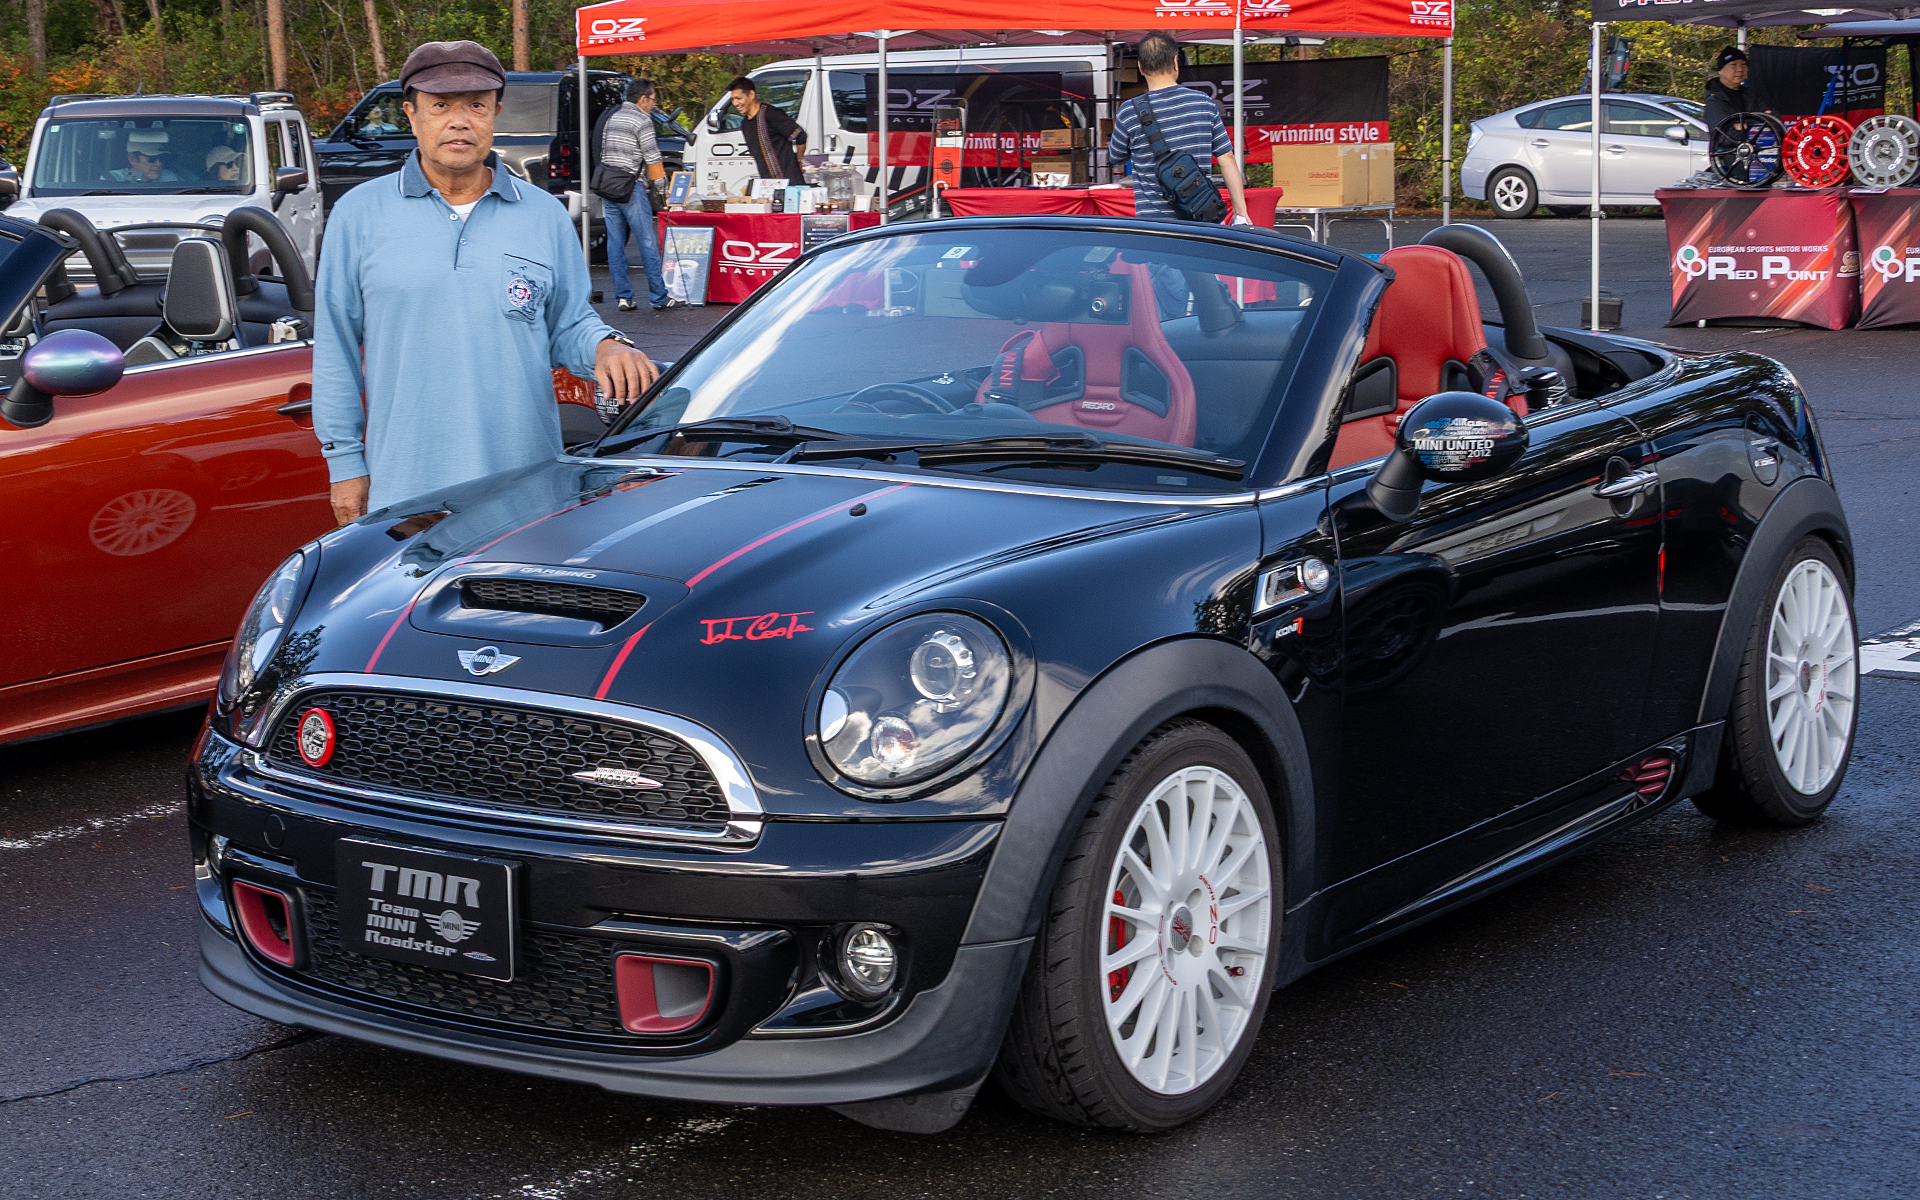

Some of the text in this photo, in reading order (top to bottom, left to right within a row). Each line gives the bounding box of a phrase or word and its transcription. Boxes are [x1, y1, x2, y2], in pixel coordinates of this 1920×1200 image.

[588, 36, 647, 45] RACING
[1339, 122, 1379, 144] style
[964, 133, 1015, 154] inning
[1746, 245, 1774, 253] SPORTS
[1801, 244, 1829, 252] WORKS
[719, 267, 781, 277] RACIN
[1000, 352, 1018, 387] MINI
[1082, 400, 1117, 411] RECARO
[1415, 439, 1495, 451] MINI UNITED
[1467, 448, 1492, 458] 2012
[472, 653, 496, 664] MINI
[594, 773, 638, 787] WORKS
[361, 861, 481, 909] TMR
[368, 897, 420, 918] Team
[366, 913, 417, 934] MINI
[442, 921, 461, 932] MINI
[364, 929, 458, 957] Roadster
